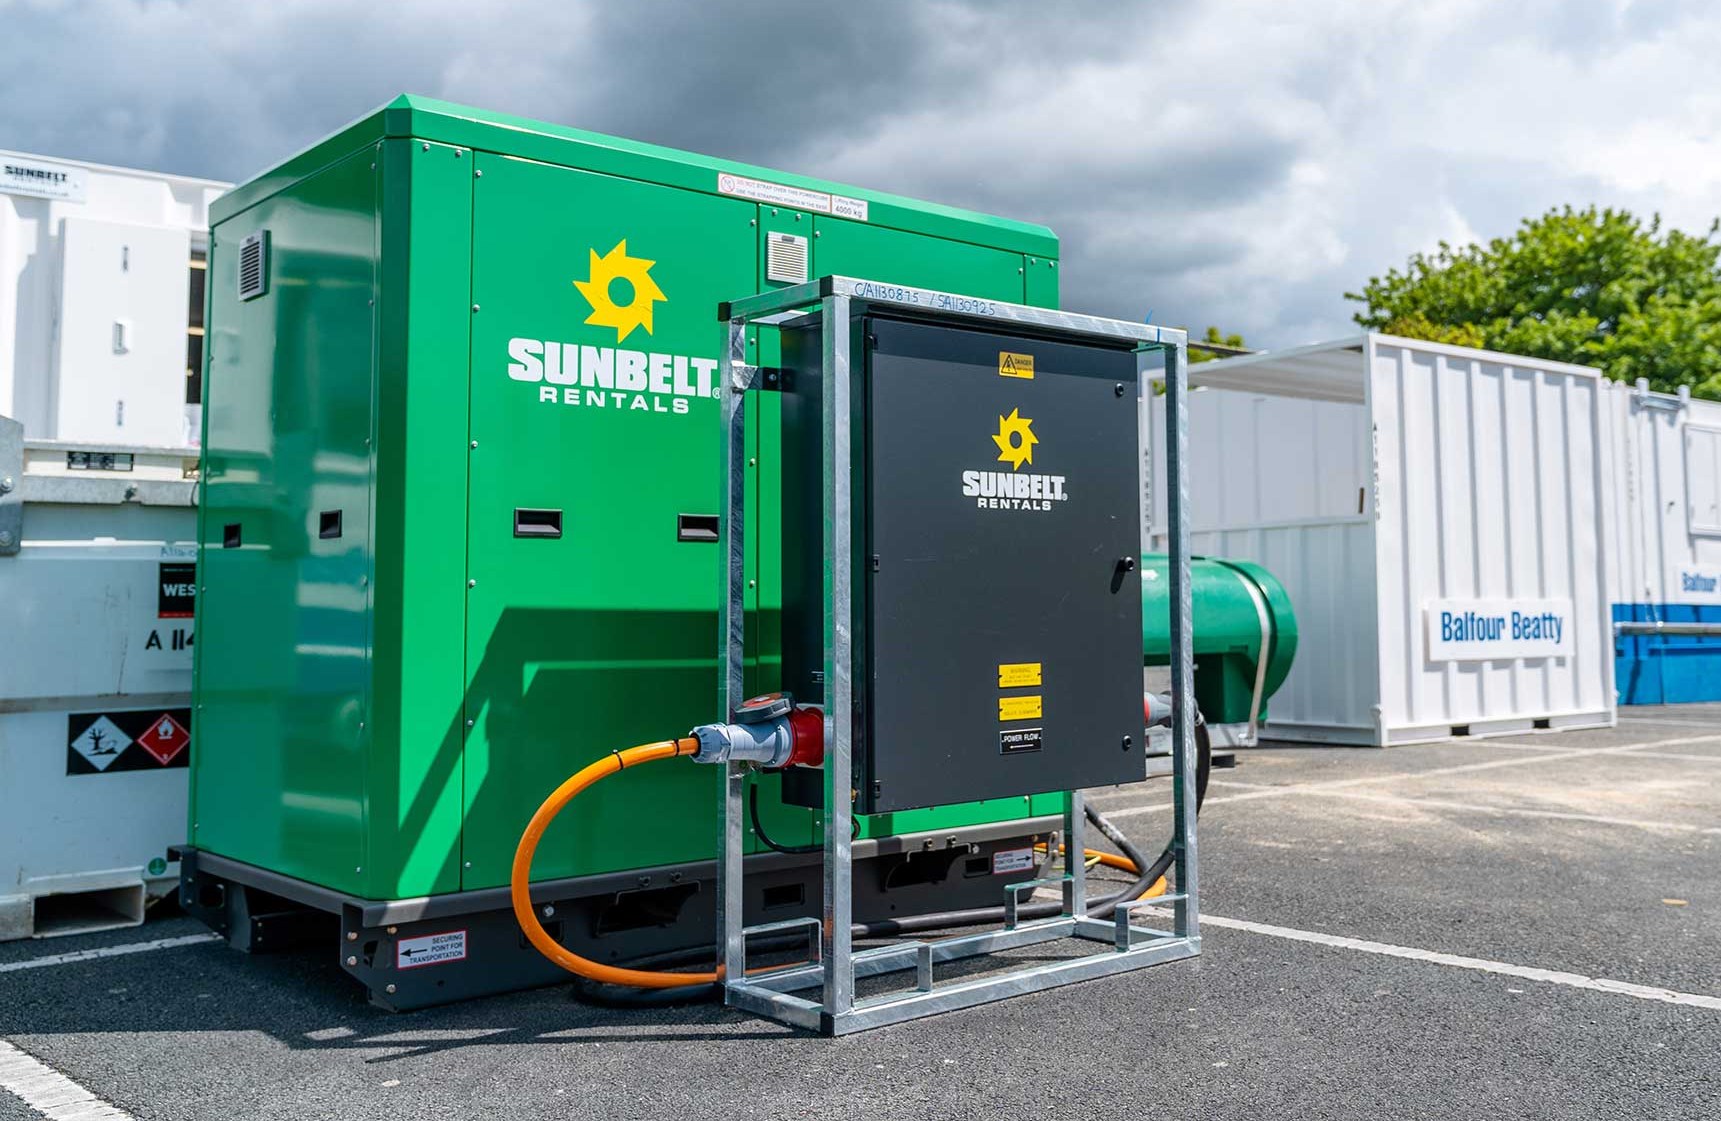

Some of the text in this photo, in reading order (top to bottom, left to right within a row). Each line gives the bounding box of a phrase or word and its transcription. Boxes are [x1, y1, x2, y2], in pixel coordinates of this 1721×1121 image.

[854, 208, 863, 219] kg
[508, 337, 718, 398] SUNBELT
[539, 385, 689, 414] RENTALS
[962, 470, 1066, 501] SUNBELT
[977, 498, 1051, 511] RENTALS
[1441, 611, 1563, 644] Balfour Beatty
[1003, 733, 1039, 743] POWER FLOW
[432, 933, 463, 945] SECURING
[431, 941, 463, 953] POINT FOR
[409, 950, 463, 964] TRANSPORTATION
